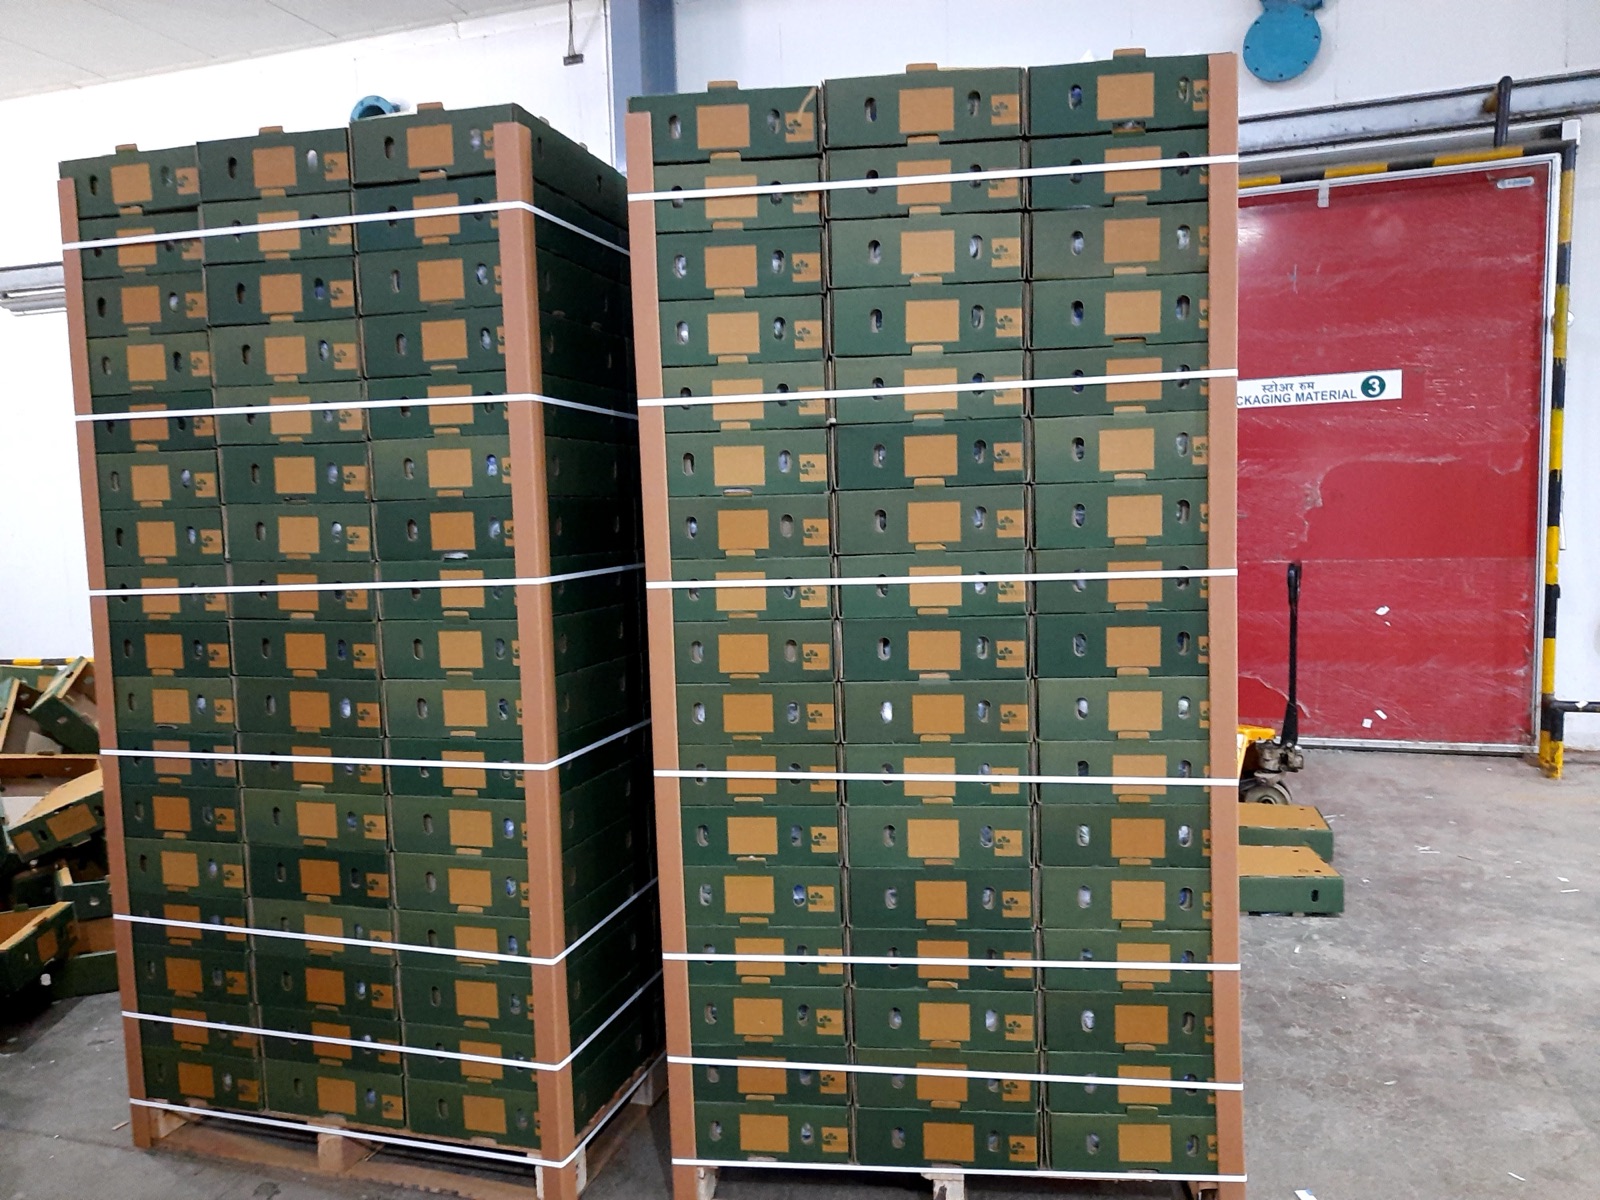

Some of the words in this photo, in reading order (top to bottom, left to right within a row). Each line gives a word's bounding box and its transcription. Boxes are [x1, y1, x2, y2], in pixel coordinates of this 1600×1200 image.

[1262, 381, 1294, 393] स्टोअर
[1367, 378, 1380, 396] 3
[1295, 389, 1357, 403] MATERIAL
